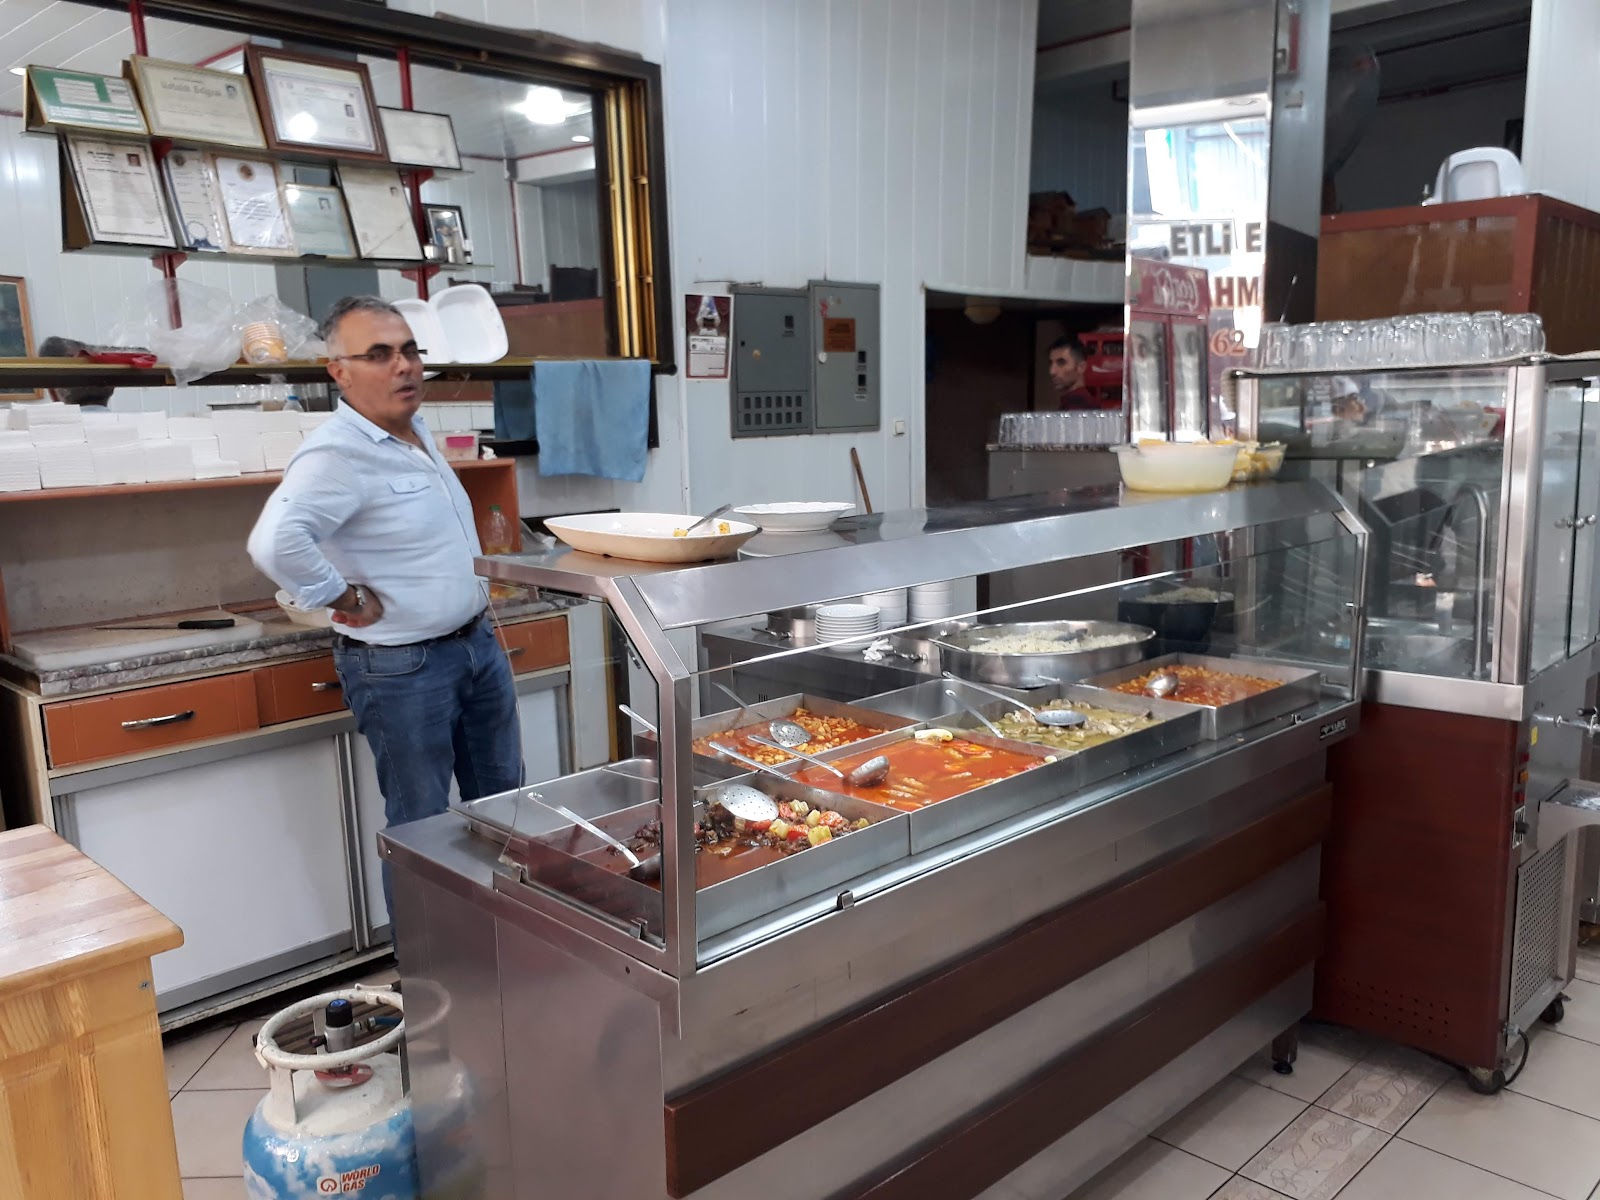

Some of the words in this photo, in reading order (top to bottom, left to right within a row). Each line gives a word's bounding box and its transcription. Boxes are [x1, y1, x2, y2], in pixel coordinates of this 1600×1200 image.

[1212, 328, 1247, 357] 62
[342, 1165, 379, 1182] WORLD
[343, 1179, 364, 1191] GAS
